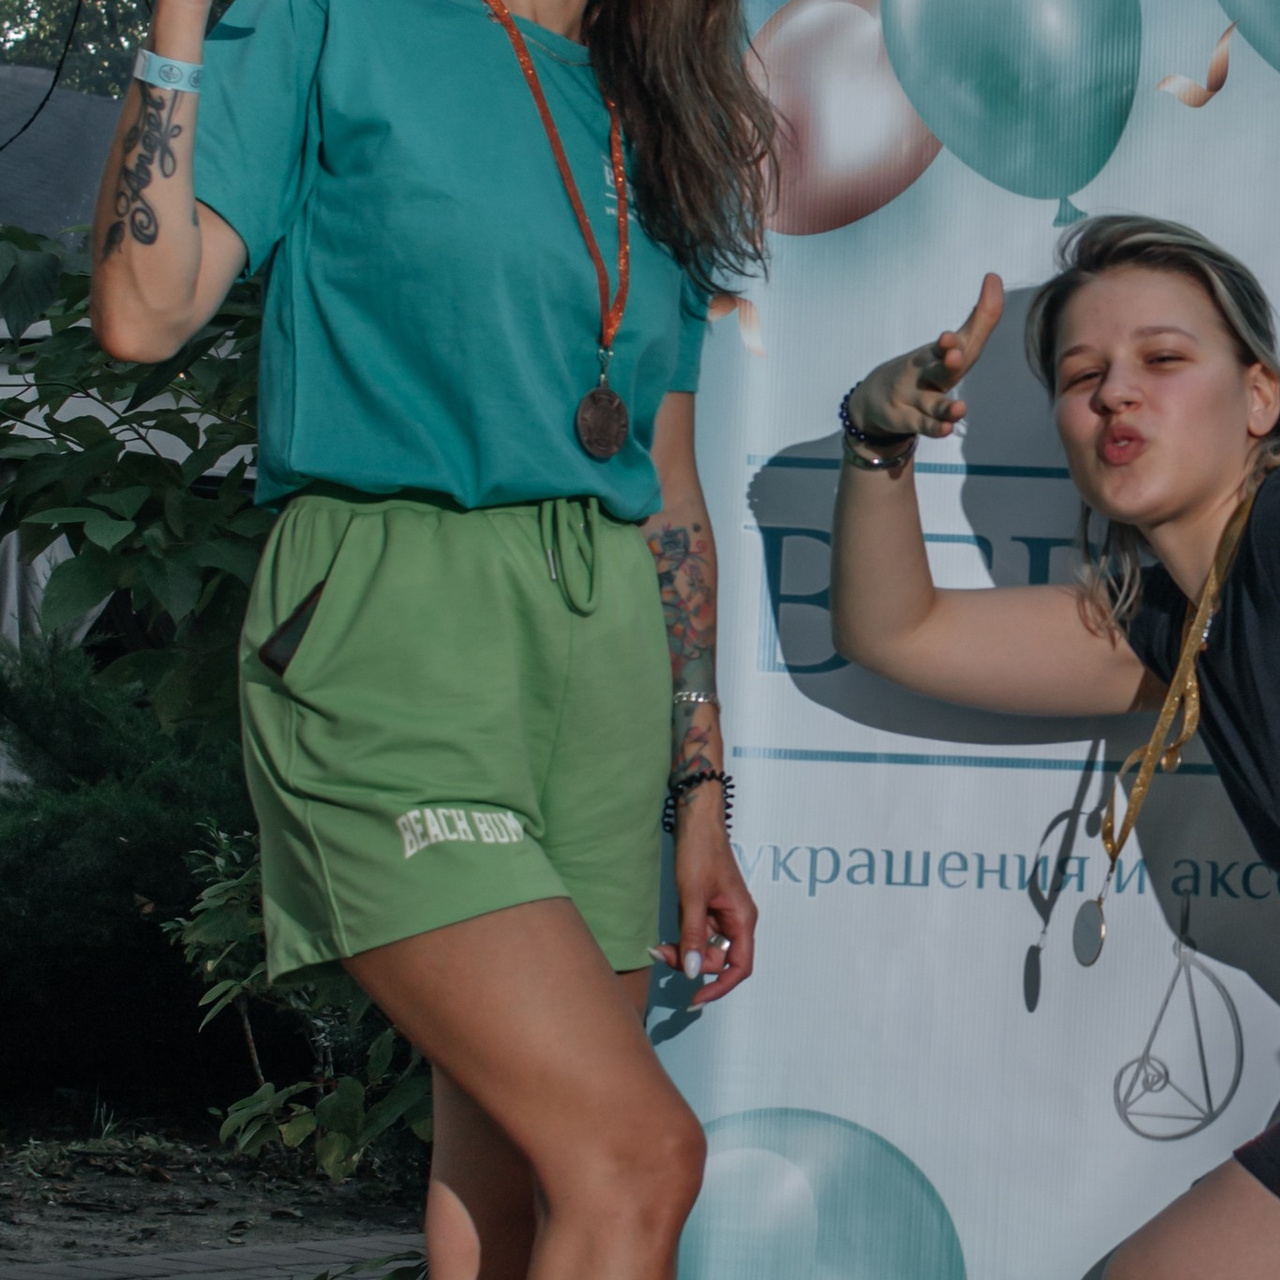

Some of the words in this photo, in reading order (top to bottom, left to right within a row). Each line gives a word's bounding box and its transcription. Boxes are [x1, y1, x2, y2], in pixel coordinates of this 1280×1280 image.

[397, 807, 475, 859] BEACH
[472, 810, 524, 843] BUM
[1115, 858, 1147, 895] и
